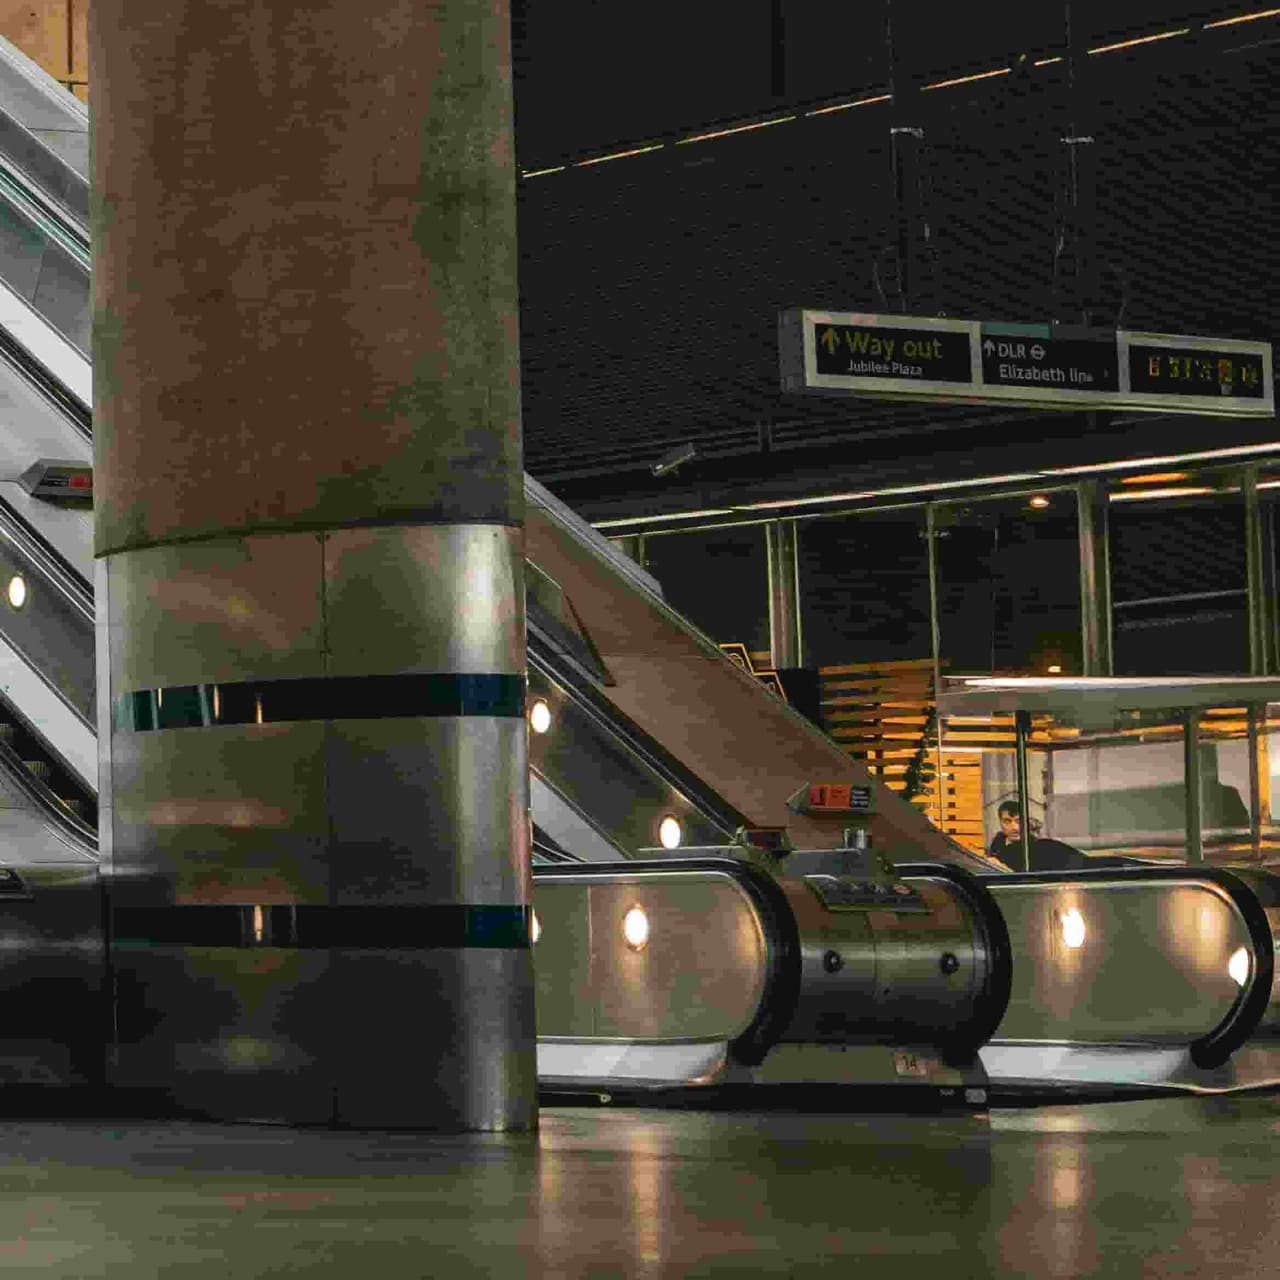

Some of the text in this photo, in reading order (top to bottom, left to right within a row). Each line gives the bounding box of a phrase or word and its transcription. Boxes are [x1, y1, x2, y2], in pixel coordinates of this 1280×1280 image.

[846, 329, 944, 361] Way out
[998, 342, 1027, 360] DLR
[848, 359, 924, 376] Jubilee Plaza
[999, 363, 1067, 384] Elizabeth
